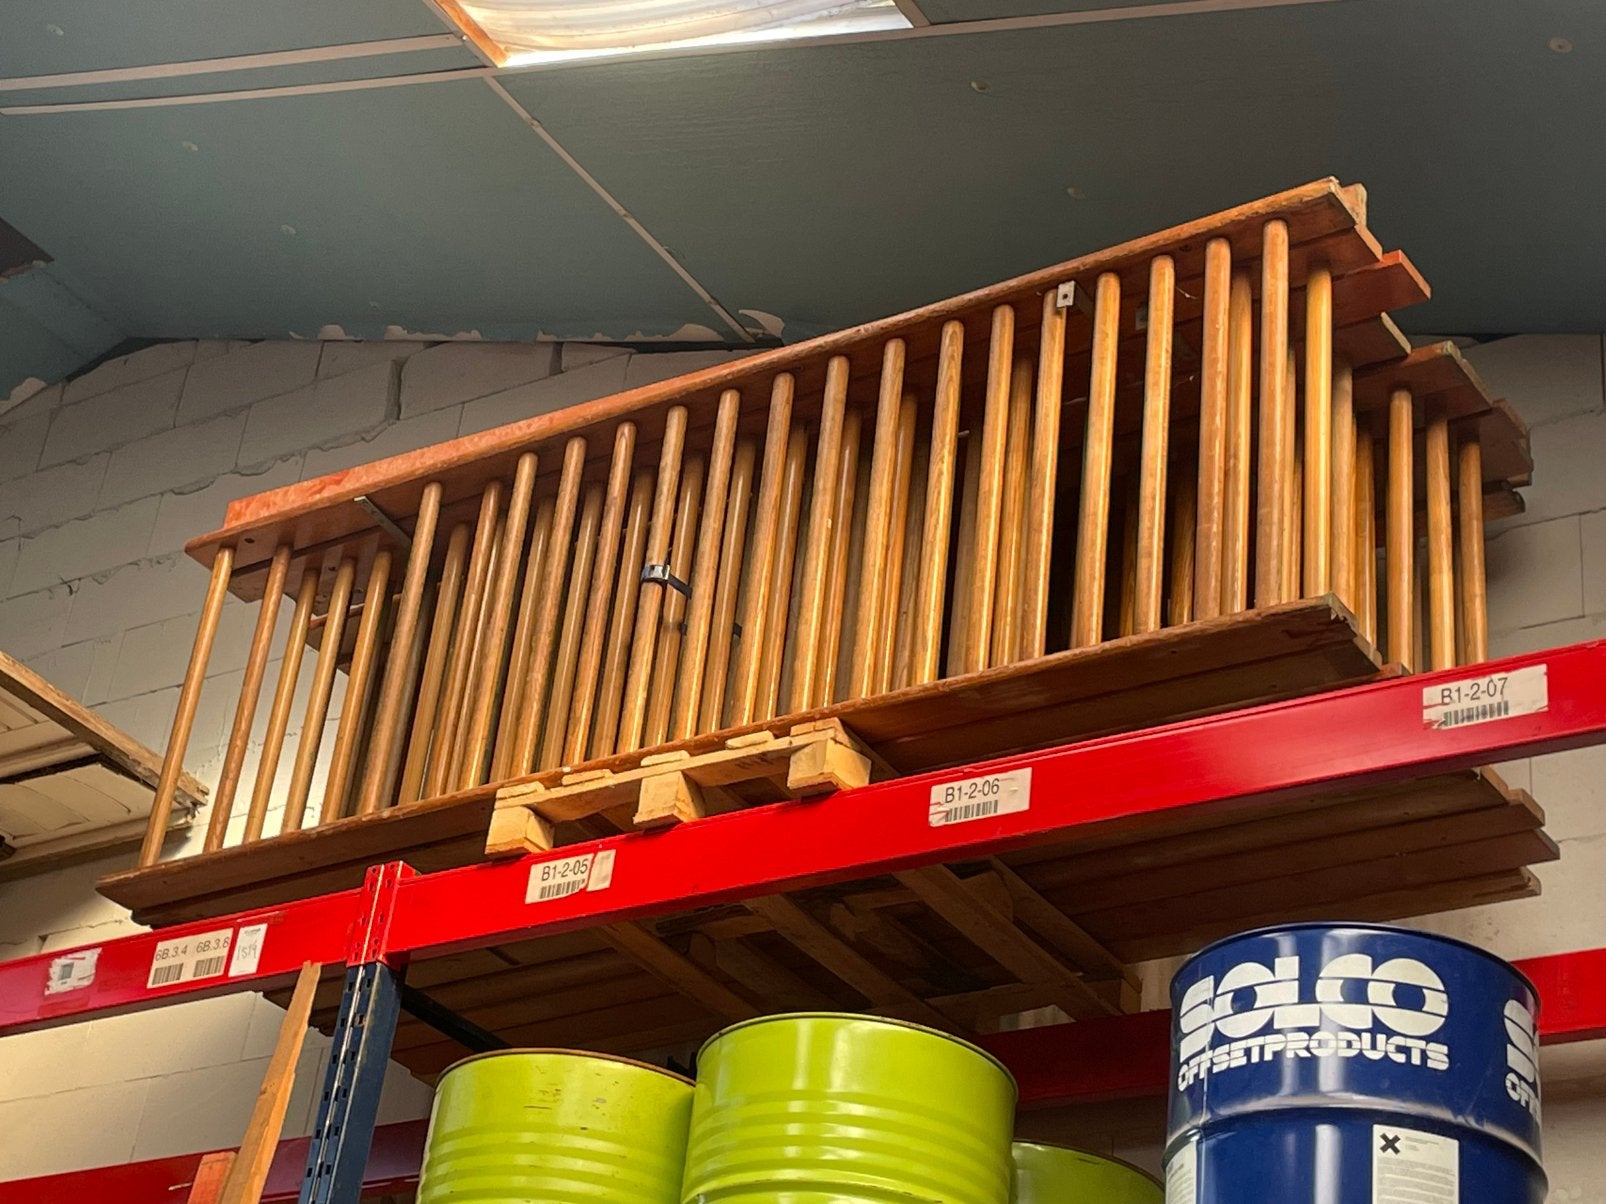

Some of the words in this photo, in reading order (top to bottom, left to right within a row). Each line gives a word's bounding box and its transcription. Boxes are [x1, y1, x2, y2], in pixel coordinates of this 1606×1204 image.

[1441, 677, 1508, 705] B1-2-07
[945, 778, 1000, 803] B1-2-06
[541, 858, 589, 882] B1-2-05
[155, 945, 189, 962] 6B.3.4
[1179, 953, 1449, 1064] SOLCO
